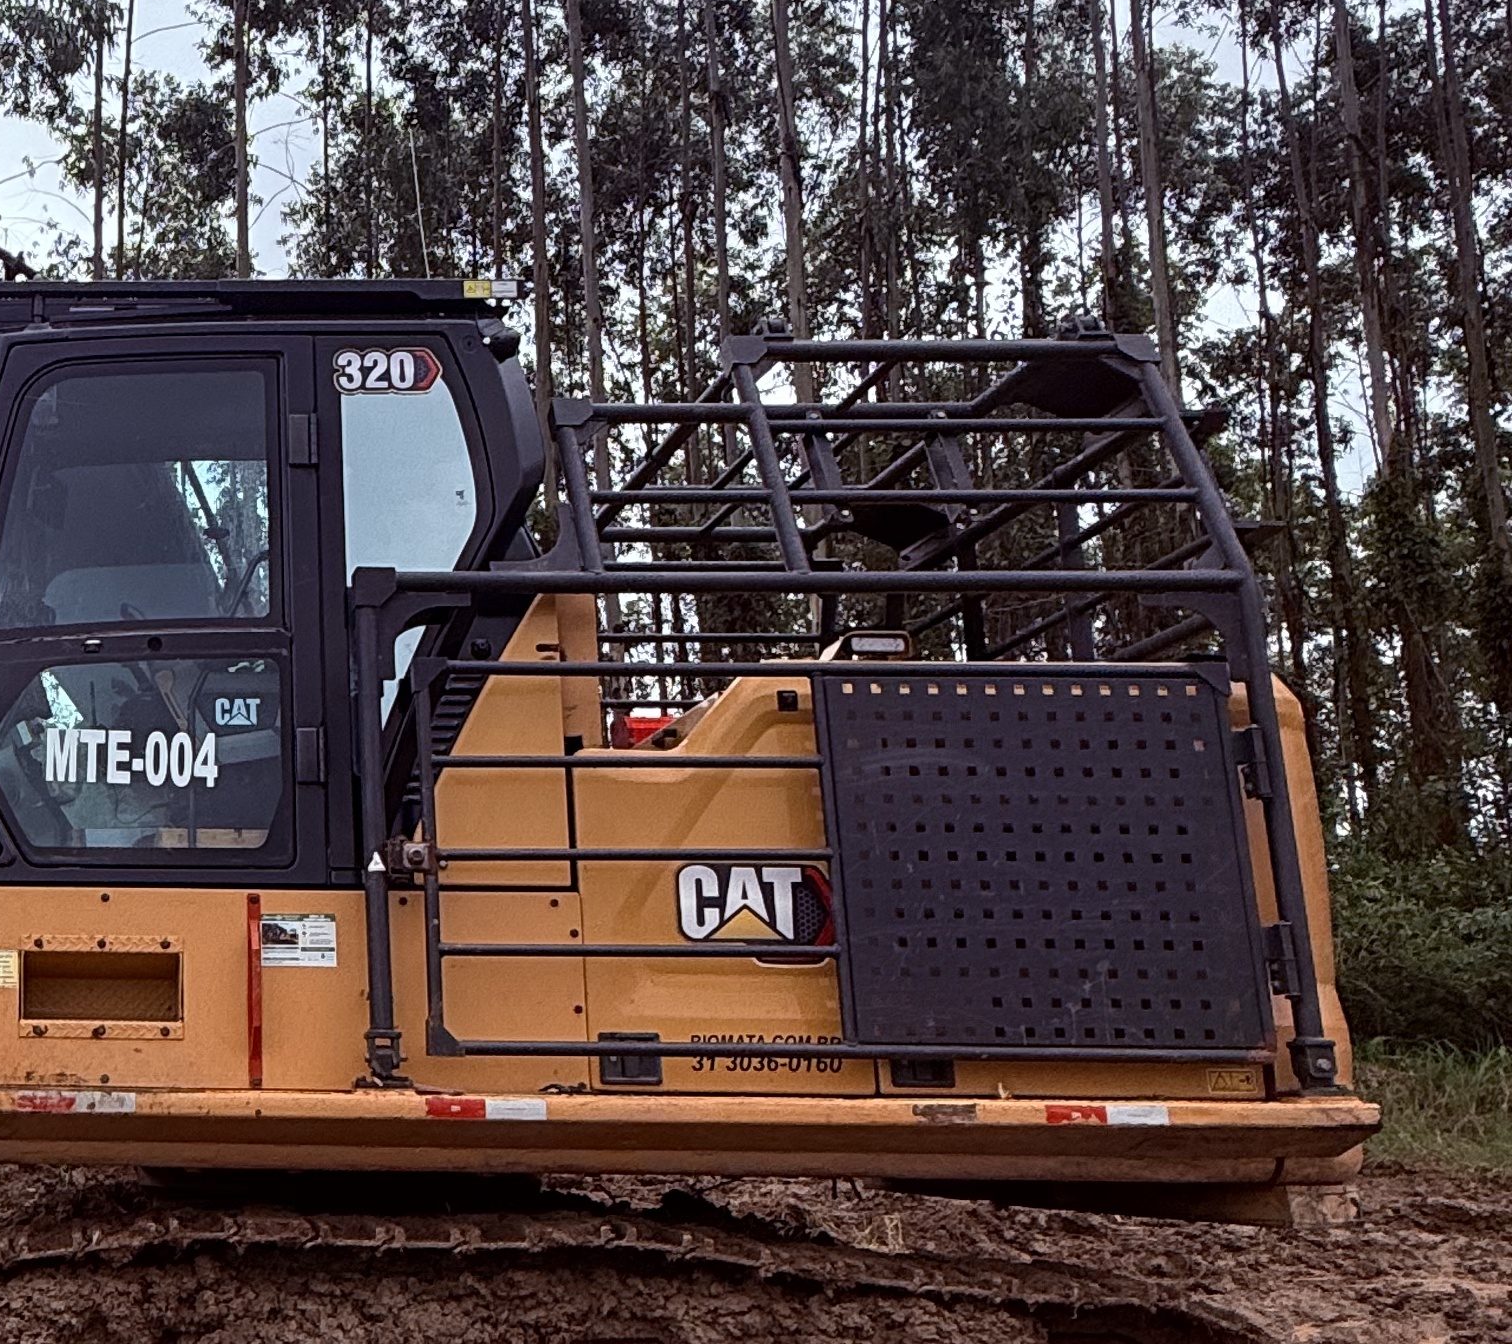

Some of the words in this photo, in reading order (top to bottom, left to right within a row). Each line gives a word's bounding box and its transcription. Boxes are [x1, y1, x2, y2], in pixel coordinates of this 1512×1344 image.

[336, 350, 415, 390] 320
[214, 697, 261, 726] CAT
[44, 727, 219, 788] MTE-004
[678, 864, 803, 940] CAT
[690, 1056, 717, 1072] 31
[725, 1055, 843, 1074] 3036-0160
